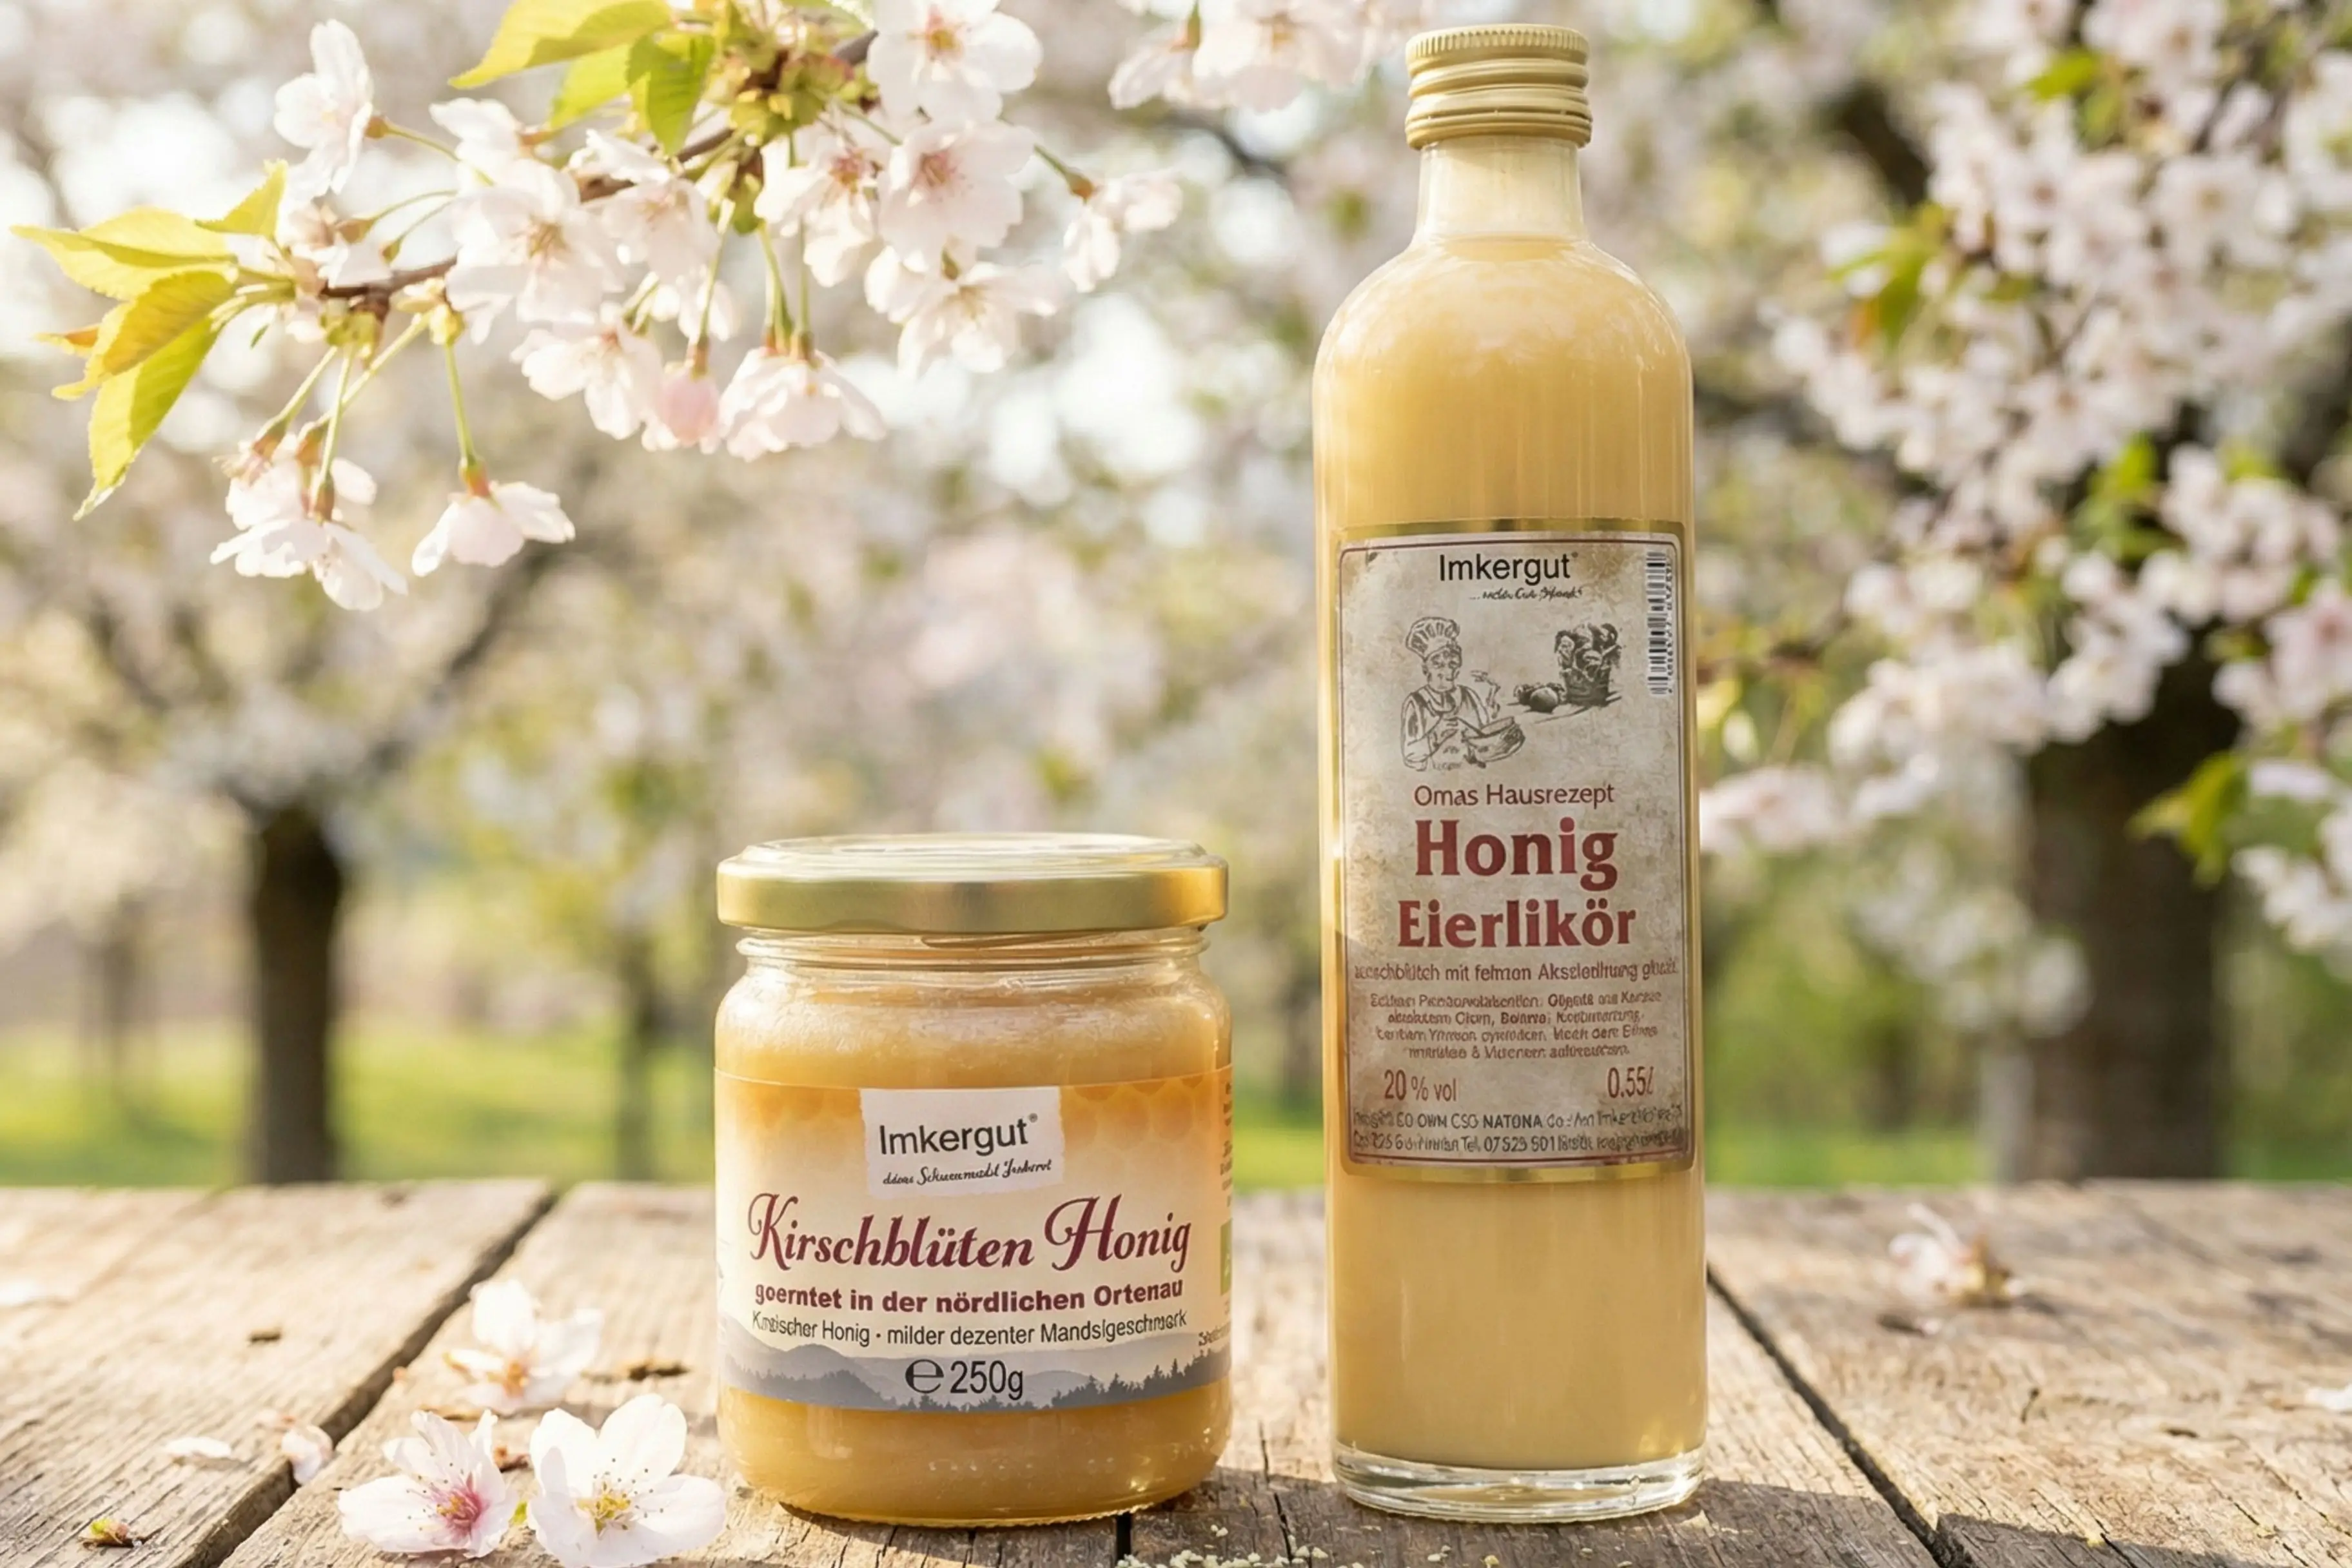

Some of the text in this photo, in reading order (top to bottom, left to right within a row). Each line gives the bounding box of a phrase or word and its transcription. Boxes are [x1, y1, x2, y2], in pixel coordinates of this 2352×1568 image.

[1440, 554, 1571, 586] Imkergut
[1414, 783, 1614, 809] Omas Hausrezept
[1415, 816, 1618, 892] Honig
[1398, 898, 1636, 948] Eierlikör
[1446, 965, 1469, 981] mit
[1384, 1069, 1456, 1101] 20 % vol
[879, 1118, 1028, 1157] Imkergut
[748, 1192, 1192, 1273] Kirschblüten Honig
[850, 1289, 873, 1311] in
[882, 1291, 927, 1313] der
[936, 1290, 1084, 1313] nördlichen
[1093, 1279, 1184, 1307] Ortenau
[822, 1319, 870, 1348] Honig
[887, 1326, 945, 1345] milder
[950, 1326, 1035, 1346] dezenter
[950, 1359, 1024, 1400] 250g
